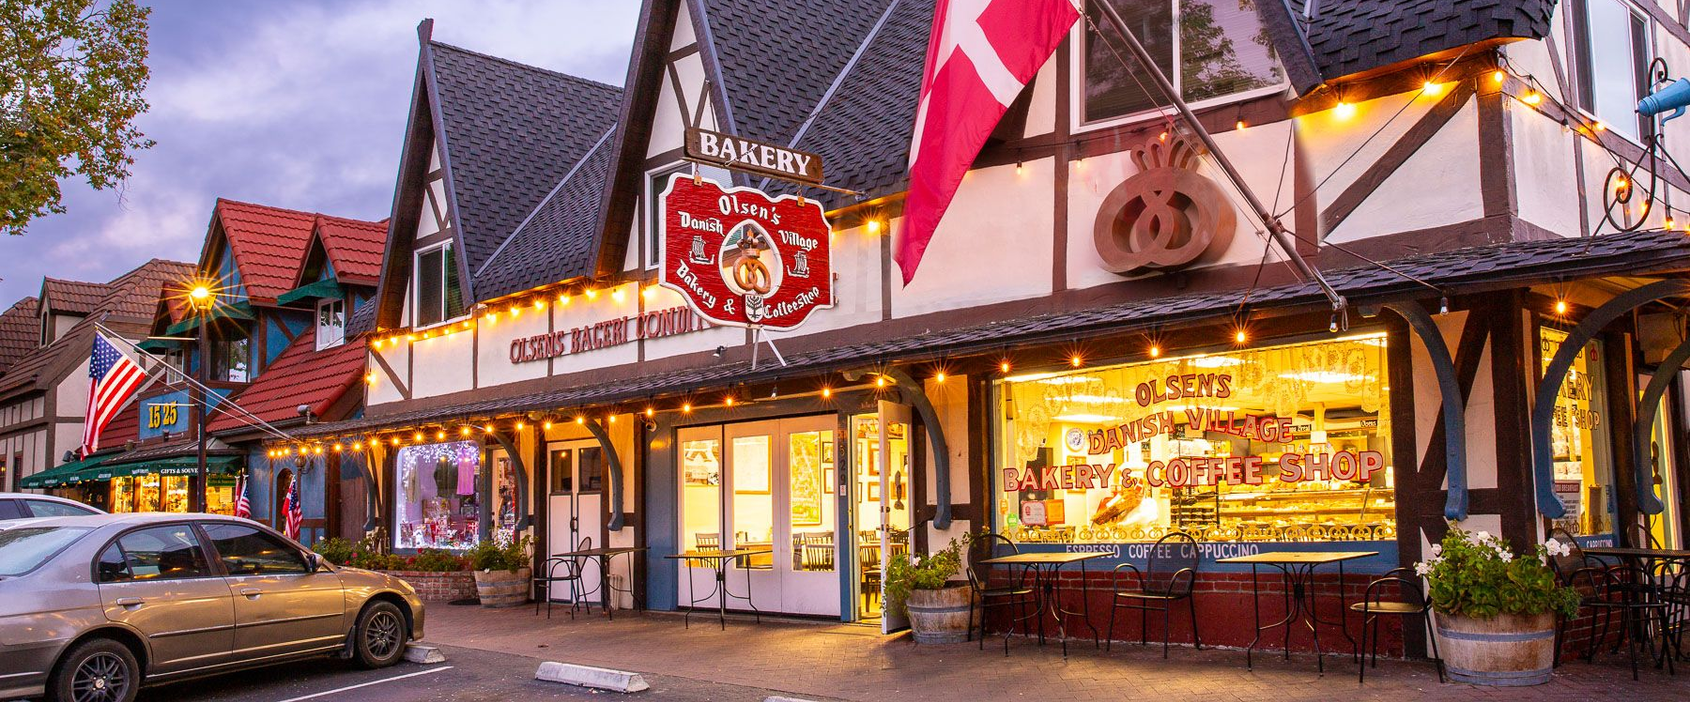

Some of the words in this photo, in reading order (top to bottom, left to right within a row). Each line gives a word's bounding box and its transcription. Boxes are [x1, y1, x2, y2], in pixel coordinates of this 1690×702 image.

[700, 132, 811, 177] BAKERY
[678, 211, 725, 237] Danish
[718, 195, 781, 226] Olsen's
[778, 230, 818, 252] Village
[676, 259, 716, 309] Bakery
[723, 298, 735, 315] &
[510, 330, 565, 364] OLSENS
[570, 316, 629, 354] BACERI
[1135, 373, 1231, 407] OLSEN'S
[1087, 411, 1175, 456] DANISH
[1184, 407, 1294, 443] VILLAGE
[1574, 408, 1600, 431] SHOP
[160, 468, 175, 476] GIFTS
[1003, 463, 1117, 492] BAKERY
[1146, 456, 1263, 488] COFFEE
[1279, 450, 1383, 483] SHOP
[1180, 543, 1259, 559] CAPPUCCINO
